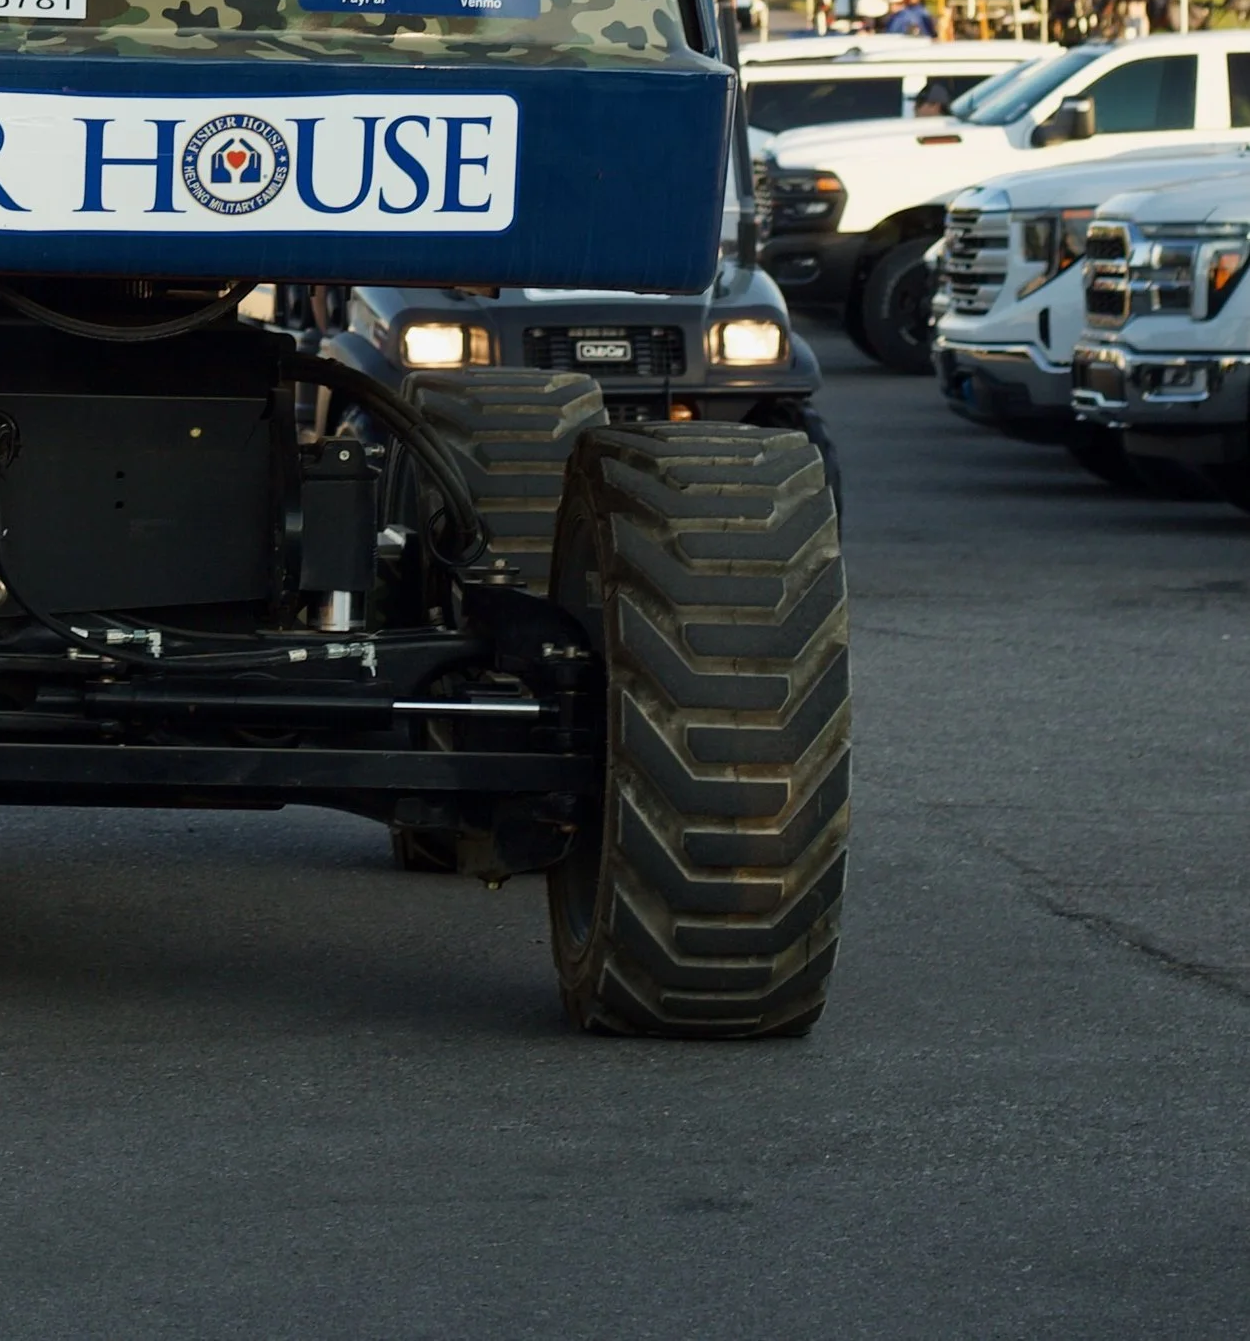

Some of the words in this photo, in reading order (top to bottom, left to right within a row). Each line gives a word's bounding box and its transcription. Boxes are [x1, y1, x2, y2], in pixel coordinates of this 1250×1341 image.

[189, 117, 236, 154] FISHER
[242, 117, 285, 153] HOUSE
[184, 166, 210, 204] HELPING
[209, 198, 255, 213] MILITARY
[258, 167, 287, 206] FAMILIES
